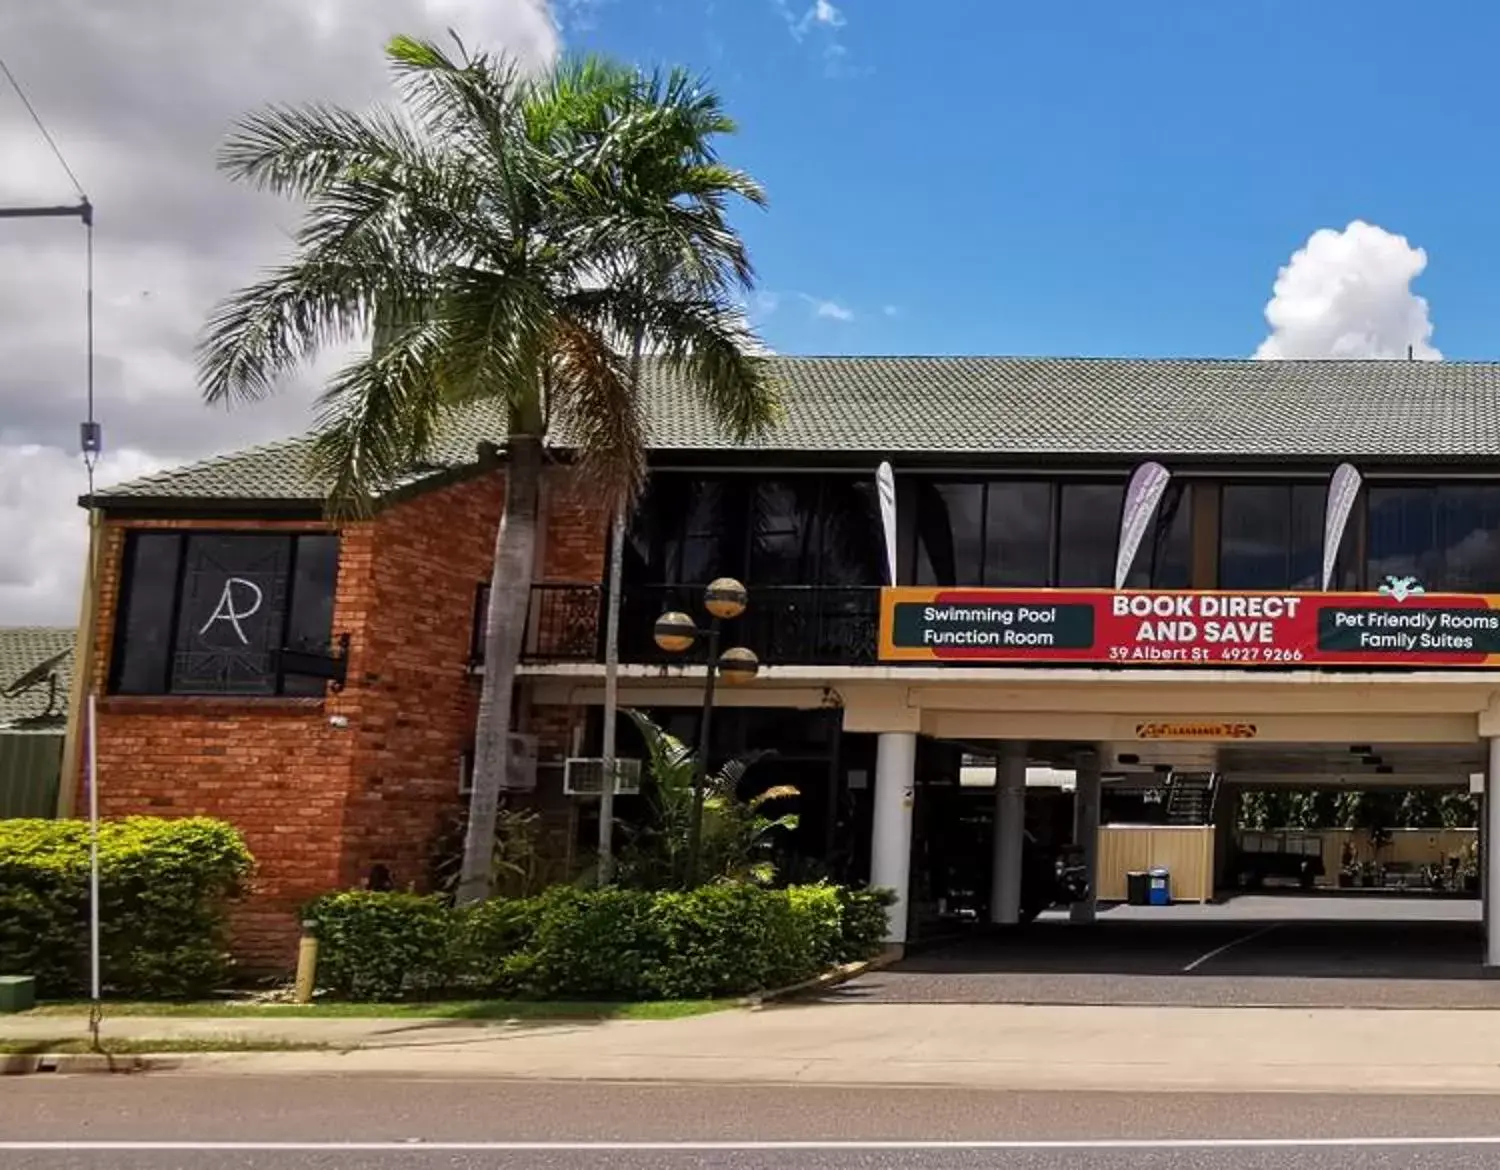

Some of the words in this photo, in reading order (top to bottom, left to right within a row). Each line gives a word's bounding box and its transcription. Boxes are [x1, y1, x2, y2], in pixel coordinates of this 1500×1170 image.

[1113, 595, 1194, 617] BOOK
[1200, 597, 1300, 618] DIRECT
[924, 607, 1013, 625] Swimming
[1018, 608, 1056, 623] Pool
[1335, 612, 1364, 627] Pet
[1368, 613, 1436, 630] Friendly
[1440, 613, 1499, 629] Rooms
[924, 629, 999, 645] Function
[1004, 630, 1054, 646] Room
[1136, 621, 1197, 642] AND
[1203, 622, 1273, 643] SAVE
[1361, 633, 1416, 650] Family
[1420, 633, 1473, 649] Suites
[1109, 647, 1128, 660] 39
[1132, 647, 1186, 660] Albert
[1191, 647, 1209, 661] St
[1221, 648, 1259, 661] 4927
[1263, 648, 1303, 661] 9266
